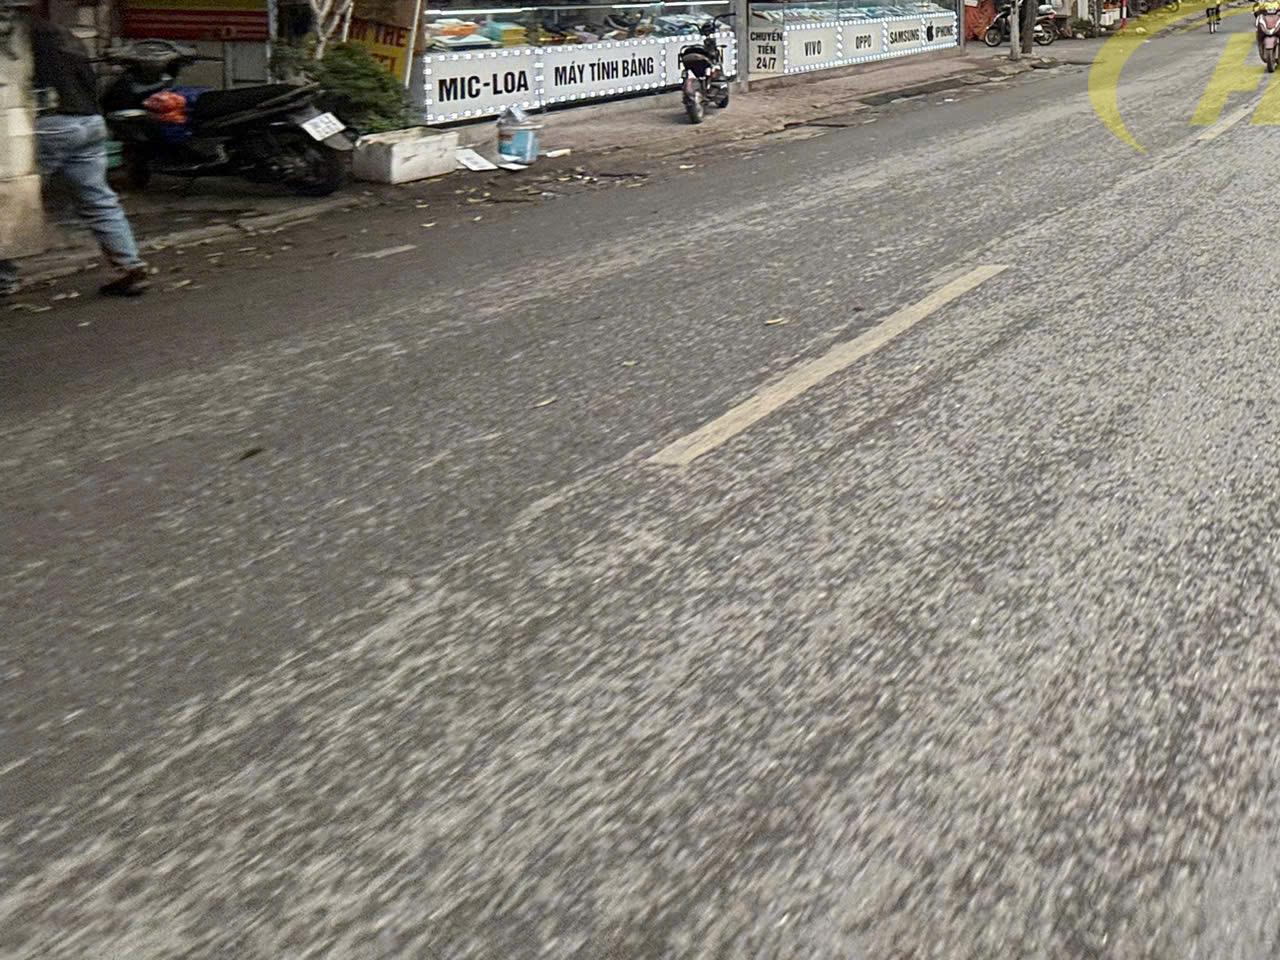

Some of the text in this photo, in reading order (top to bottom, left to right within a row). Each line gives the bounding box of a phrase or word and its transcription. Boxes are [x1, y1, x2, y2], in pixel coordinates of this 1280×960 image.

[855, 34, 872, 50] OPPO
[890, 28, 920, 43] SAMSUNG
[804, 39, 822, 57] VIVO
[555, 60, 586, 86] MÁY
[590, 57, 619, 82] TÍNH
[622, 53, 655, 78] BẢNG
[756, 57, 776, 70] 24/7
[438, 70, 529, 102] MIC-LOA
